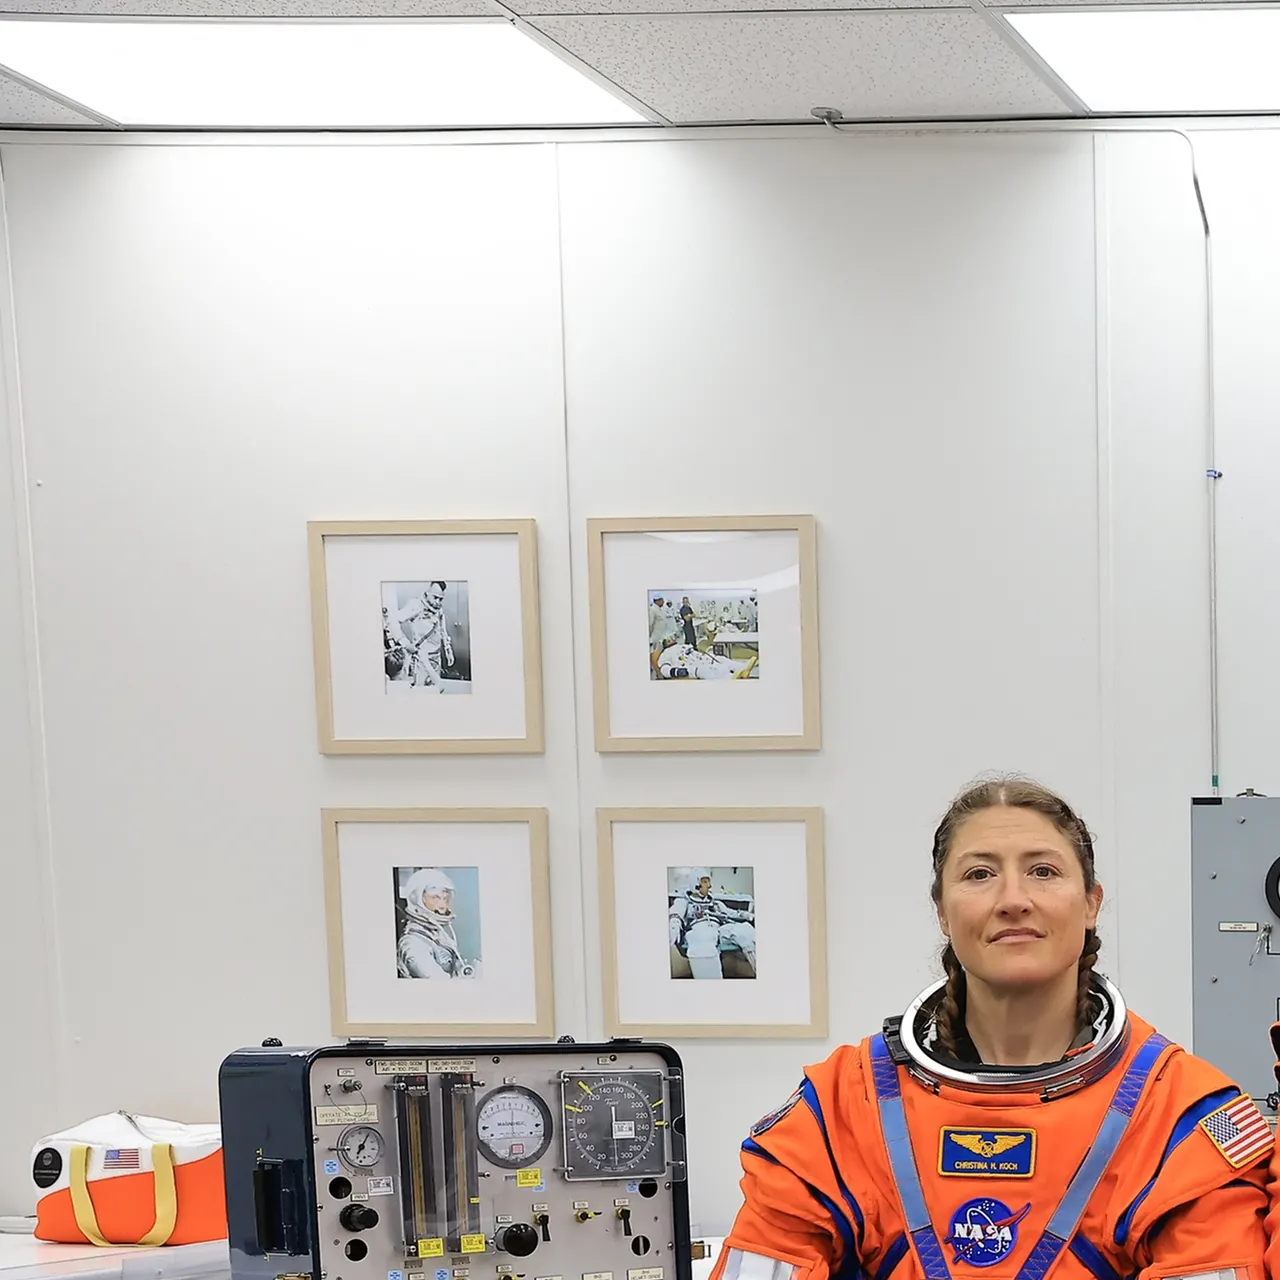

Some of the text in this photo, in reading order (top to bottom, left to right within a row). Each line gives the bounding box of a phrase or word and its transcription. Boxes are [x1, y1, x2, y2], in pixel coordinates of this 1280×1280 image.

[954, 1161, 988, 1170] CHRISTINA
[999, 1162, 1018, 1170] KOCH
[954, 1223, 1012, 1241] NASA
